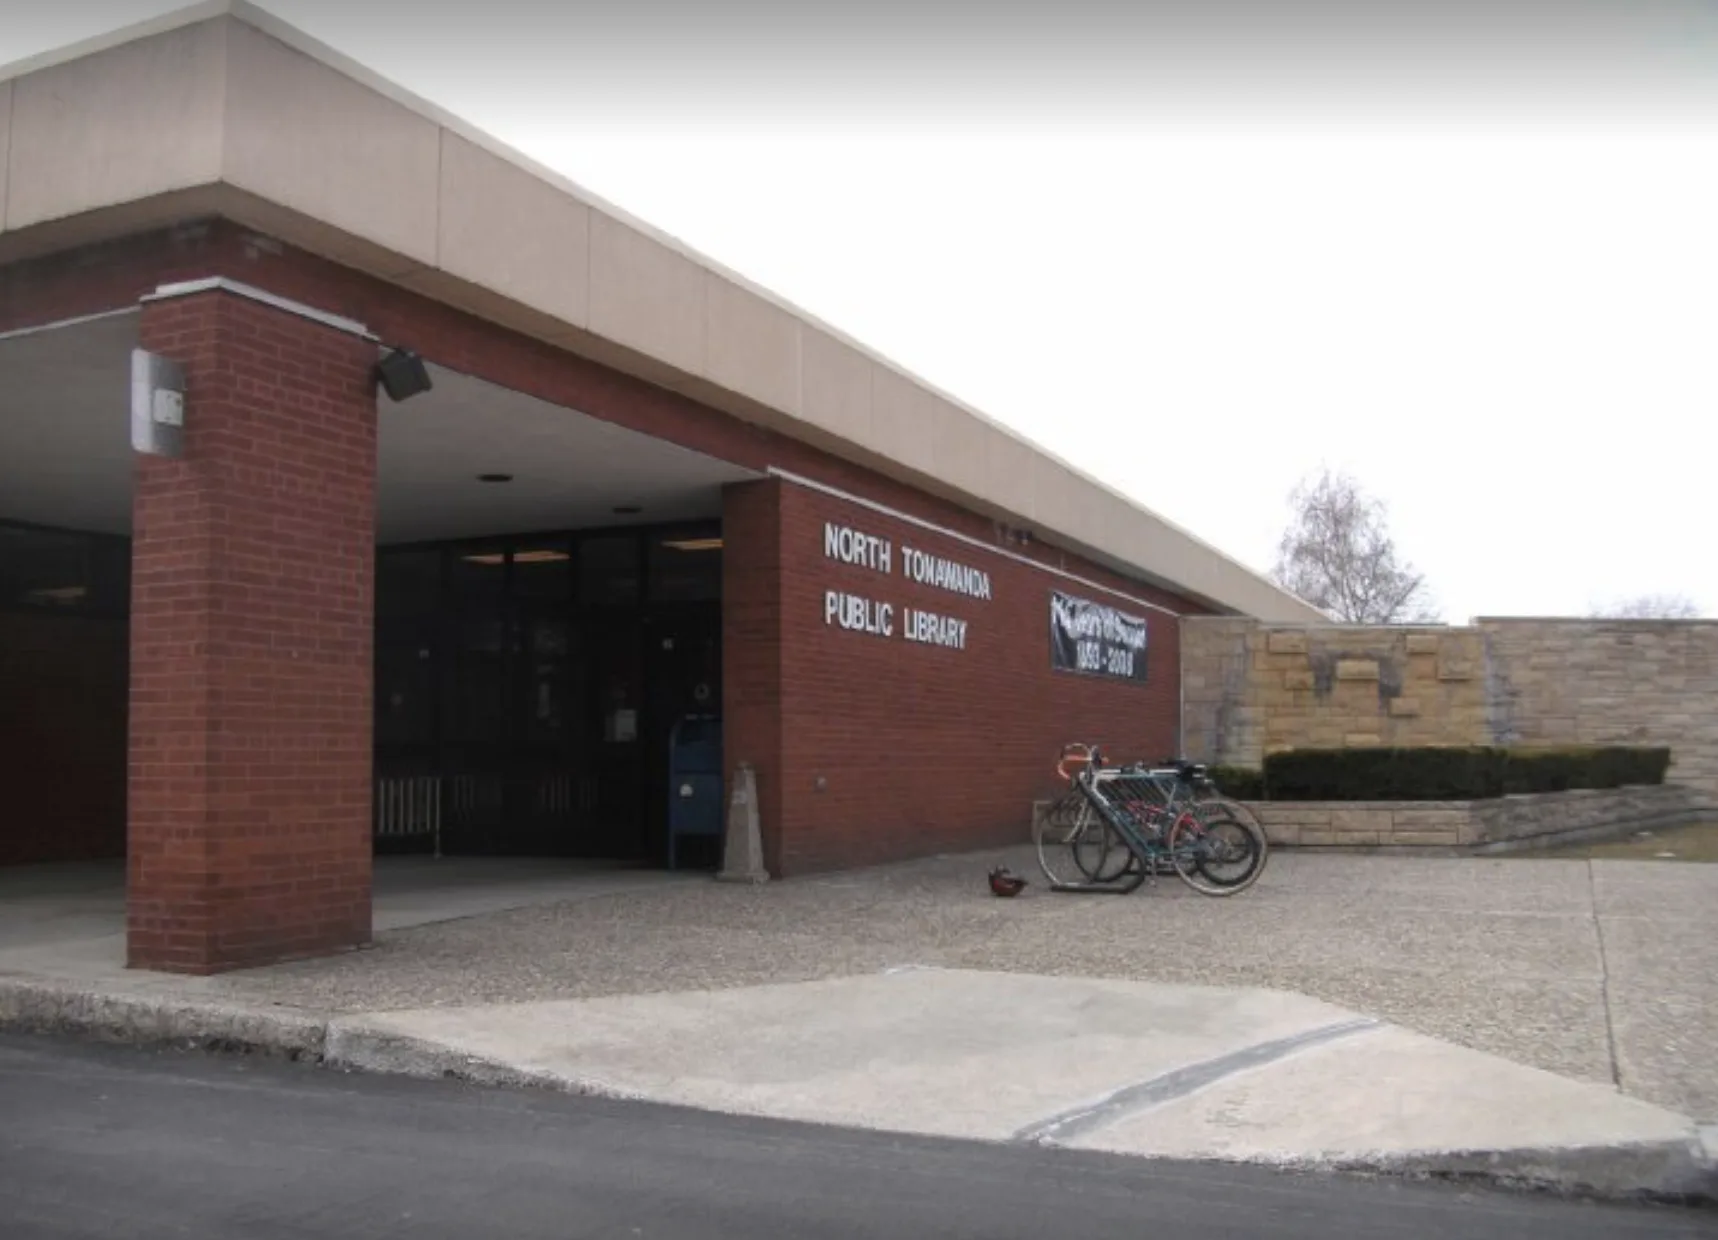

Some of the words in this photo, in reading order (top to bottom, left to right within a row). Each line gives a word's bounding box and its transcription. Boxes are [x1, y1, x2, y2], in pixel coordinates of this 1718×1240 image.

[825, 522, 892, 574] NORTH
[902, 546, 991, 600] TONAWANDA
[825, 591, 894, 637] PUBLIC
[903, 607, 968, 650] LIBRARY
